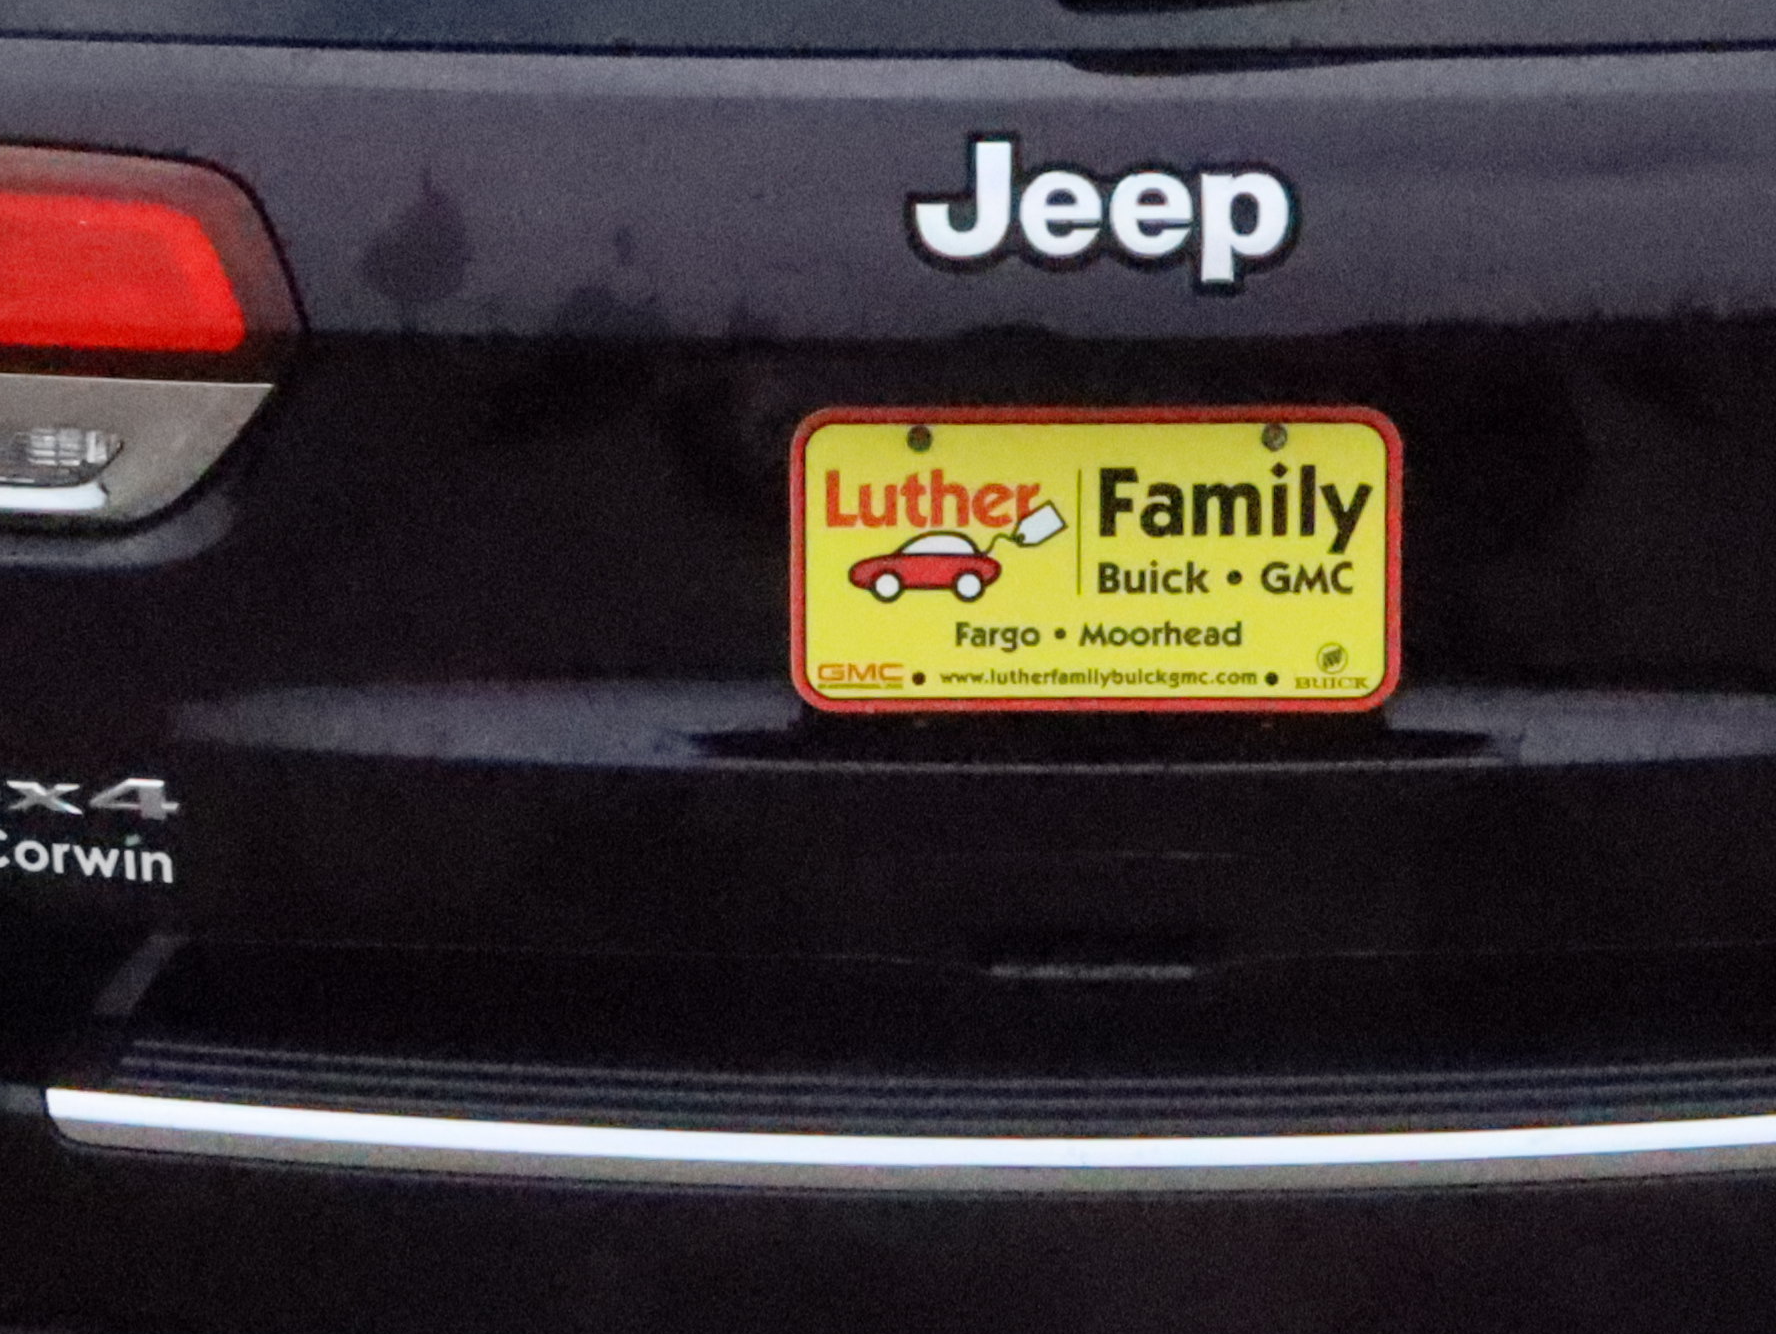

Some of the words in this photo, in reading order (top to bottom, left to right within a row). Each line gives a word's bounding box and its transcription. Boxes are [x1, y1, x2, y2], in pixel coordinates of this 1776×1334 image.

[914, 140, 1290, 284] Jeep
[825, 469, 1041, 528] Luther
[1099, 462, 1373, 555] Family
[1098, 561, 1211, 596] Buick
[1261, 561, 1355, 596] GMC
[955, 622, 1042, 653] Fargo
[1079, 621, 1245, 649] Moorhead
[818, 663, 904, 683] GMC
[940, 668, 1259, 688] www.lutherfamilybuickgmc.com
[1294, 676, 1369, 690] BUICK
